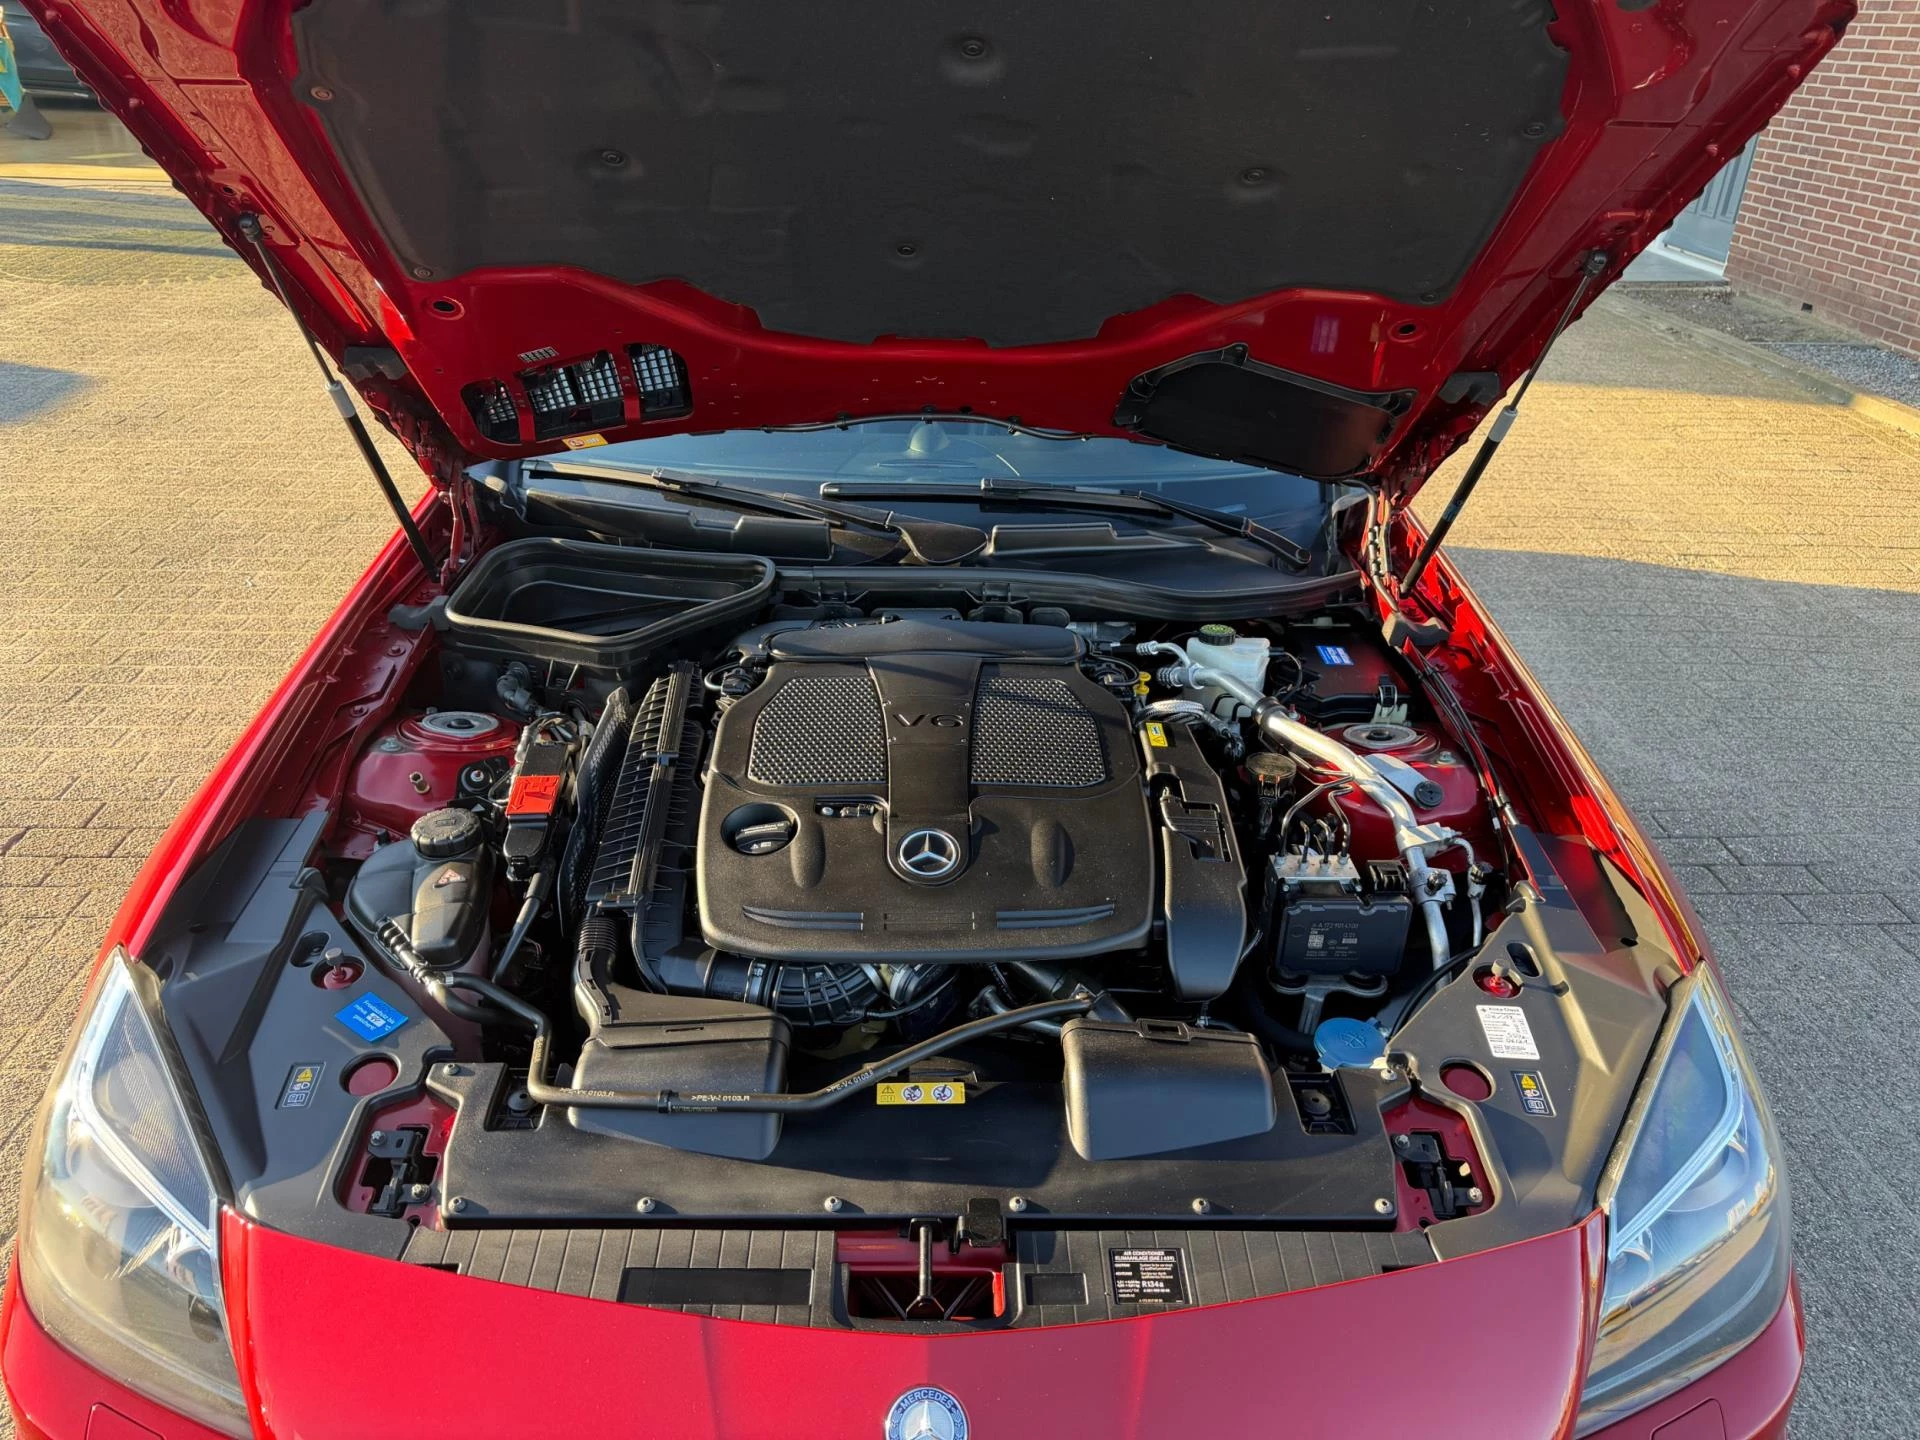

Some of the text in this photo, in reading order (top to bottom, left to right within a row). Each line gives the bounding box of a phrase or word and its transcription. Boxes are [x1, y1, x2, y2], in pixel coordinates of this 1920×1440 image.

[892, 713, 964, 728] V6
[1141, 1280, 1164, 1288] R134a
[900, 1390, 953, 1410] MERCEDES
